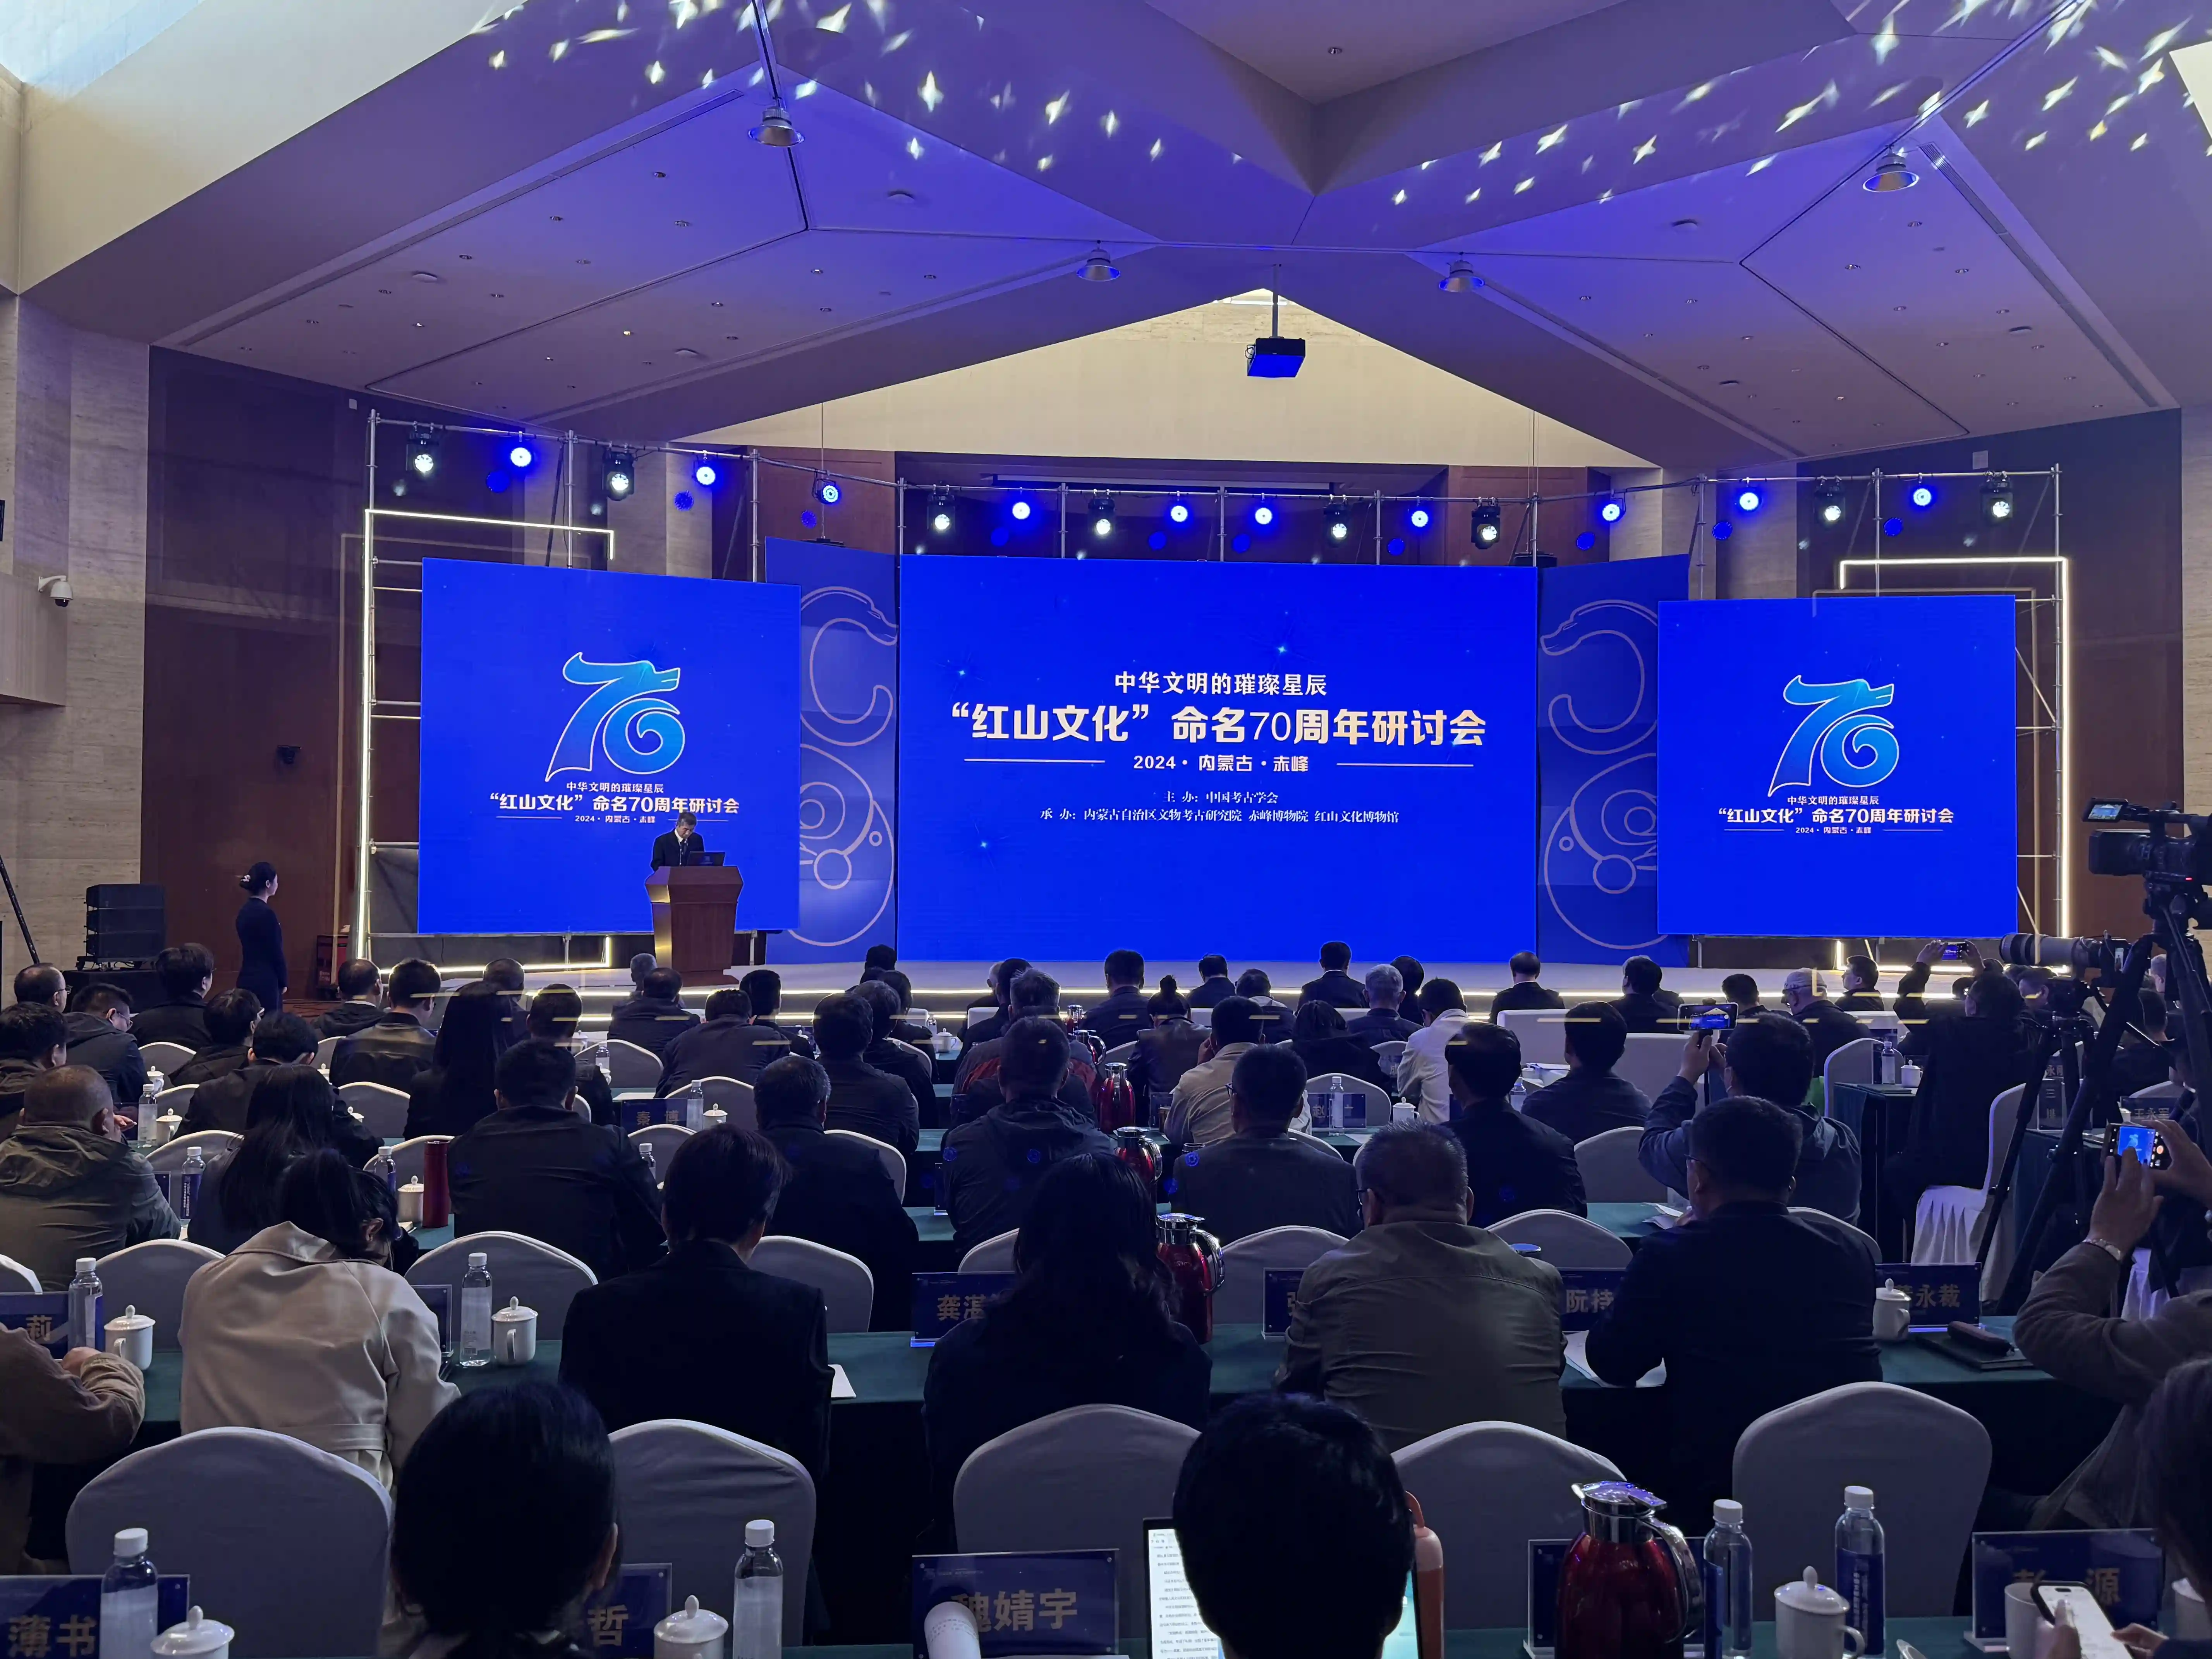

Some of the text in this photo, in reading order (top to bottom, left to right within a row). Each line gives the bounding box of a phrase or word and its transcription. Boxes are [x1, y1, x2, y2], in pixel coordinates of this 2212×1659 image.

[1115, 670, 1327, 696] 中华文明的璀璨星辰
[566, 781, 664, 794] 中华文明的璀璨星辰
[1787, 795, 1879, 805] 中华文明的璀璨星辰
[26, 1315, 52, 1341] 莉
[586, 1604, 629, 1647] 哲
